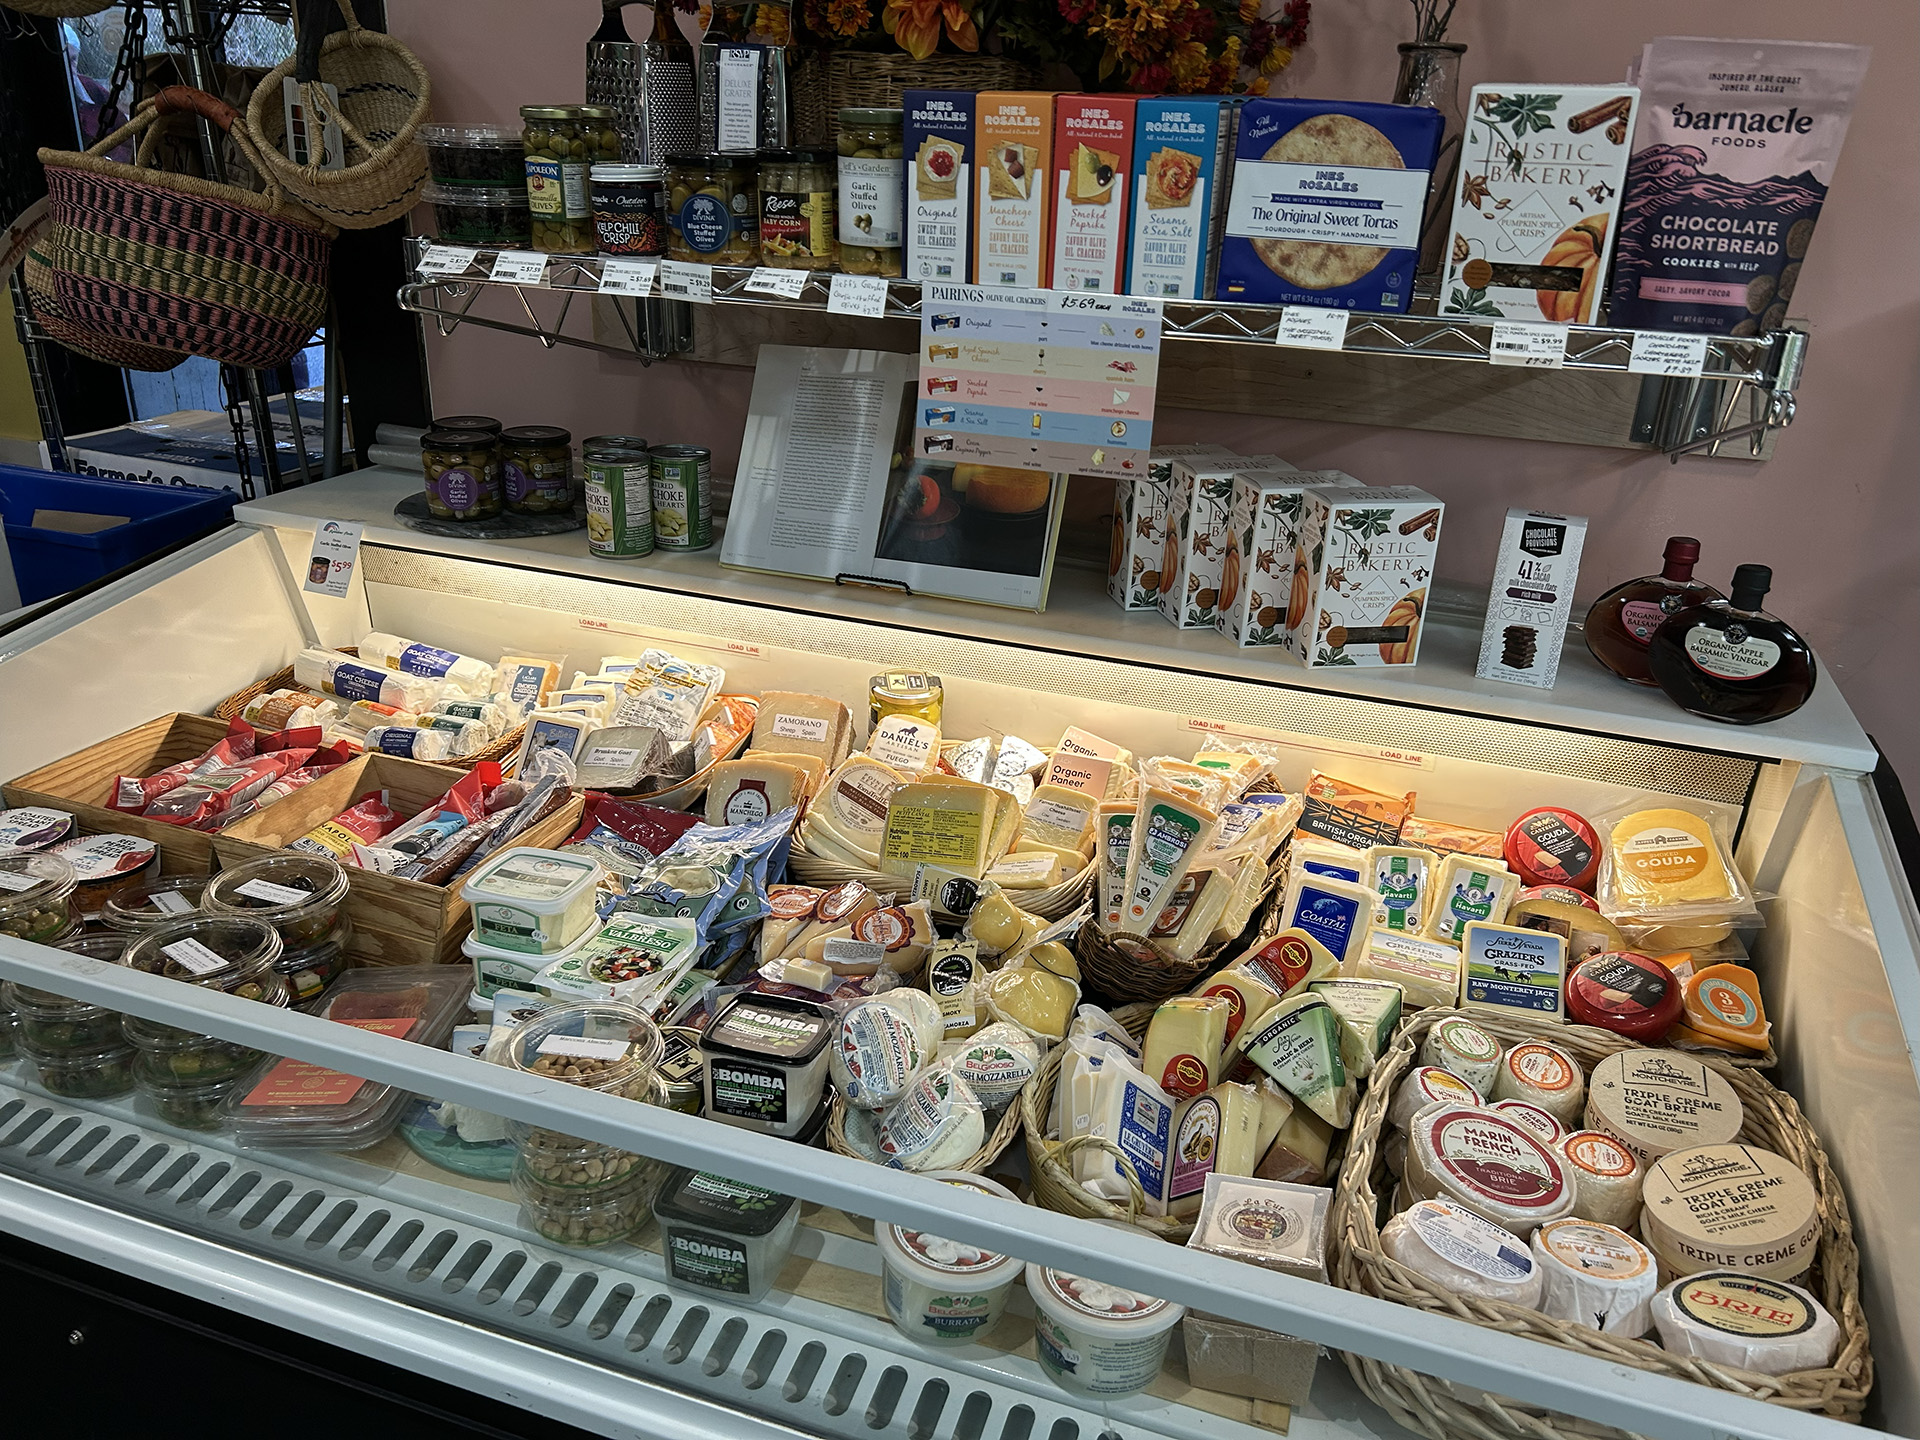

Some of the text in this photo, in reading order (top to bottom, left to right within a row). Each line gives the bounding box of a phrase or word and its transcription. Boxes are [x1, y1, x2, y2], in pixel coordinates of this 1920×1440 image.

[724, 80, 752, 88] DELUXE
[1708, 73, 1801, 84] INSPIRED BY THE COAST
[912, 110, 967, 122] ROSALES
[999, 105, 1026, 116] INES
[984, 114, 1040, 126] ROSALES
[1066, 117, 1124, 130] ROSALES
[1672, 102, 1813, 135] barnacle
[1146, 121, 1206, 134] ROSALES
[1711, 136, 1766, 149] FOODS
[1494, 140, 1594, 162] RUSTIC
[1490, 164, 1591, 186] BAKERY
[852, 182, 876, 191] Garlic
[1298, 180, 1358, 192] ROSALES
[850, 192, 878, 200] Stuffed
[852, 202, 876, 210] Olives
[764, 218, 800, 226] BABY CORN
[1252, 207, 1398, 229] The Original Sweet Tortas
[687, 222, 722, 231] Blue Cheese
[1660, 214, 1778, 236] CHOCOLATE
[603, 232, 630, 244] CRISP
[1264, 226, 1306, 234] SOURDOUGH
[1341, 232, 1379, 240] HANDMADE
[1144, 241, 1186, 254] SAVORY OLIVE
[1651, 234, 1779, 256] SHORTBREAD
[1065, 246, 1106, 260] OIL CRACKERS
[1662, 257, 1720, 270] COOKIES
[1738, 262, 1760, 272] KELP
[932, 286, 984, 302] PAIRINGS
[986, 294, 1002, 302] OLIVE
[1004, 295, 1014, 303] OIL
[1015, 296, 1046, 305] CRACKERS
[1061, 296, 1096, 309] $5.69
[1122, 306, 1156, 314] ROSALES
[589, 505, 610, 514] HEARTS
[658, 500, 684, 508] HEARTS
[1526, 528, 1557, 538] CHOCOLATE
[1526, 536, 1558, 547] PROVISIONS
[1349, 542, 1416, 555] RUSTIC
[1346, 558, 1414, 572] BAKERY
[1533, 571, 1550, 582] CACAO
[1378, 596, 1395, 604] SPICE
[1626, 610, 1662, 622] ORGANIC
[746, 646, 760, 654] LINE
[1698, 638, 1764, 658] ORGANIC APPLE
[407, 648, 452, 666] GOAT CHEESE
[1690, 644, 1769, 668] BALSAMIC VINEGAR
[336, 671, 379, 688] GOAT CHEESE
[454, 706, 475, 714] GARLIC
[778, 716, 822, 728] ZAMORANO
[1188, 720, 1208, 729] LOAD
[550, 728, 574, 739] Billie's
[880, 730, 928, 750] DANIEL'S
[886, 754, 909, 764] FUEGO
[1380, 750, 1402, 760] LOAD
[1054, 765, 1092, 780] Organic
[1051, 774, 1084, 788] Paneer
[19, 812, 56, 821] ROASTED
[730, 808, 764, 818] MANCHEGO
[7, 820, 40, 828] SPREAD
[9, 815, 51, 826] EGGPLANT
[338, 814, 370, 832] OLLI
[1332, 834, 1350, 844] DAIRY
[1536, 828, 1570, 842] GOUDA
[86, 848, 120, 858] SPREAD
[1636, 855, 1696, 868] GOUDA
[516, 873, 550, 884] FETA
[1455, 901, 1486, 916] Havarti
[1300, 910, 1346, 930] COASTAL
[494, 924, 518, 934] FETA
[607, 929, 671, 949] VALBRESO
[1484, 948, 1545, 966] GRAZIERS
[1494, 959, 1534, 970] GRASS-FED
[1600, 963, 1634, 982] GOUDA
[496, 978, 518, 988] FETA
[1472, 980, 1488, 988] RAW
[1490, 983, 1534, 995] MONTEREY
[1535, 990, 1555, 998] JACK
[1719, 991, 1734, 1006] 3
[740, 1009, 820, 1033] BOMBA
[1262, 1017, 1296, 1042] ORGANIC
[882, 1008, 894, 1026] FRESH
[888, 1026, 905, 1088] MOZZARELLA
[1272, 1052, 1294, 1068] GARLIC
[1299, 1037, 1314, 1050] HERB
[966, 1061, 1014, 1072] BELGIOIOSO
[718, 1069, 785, 1090] BOMBA
[976, 1068, 1032, 1082] MOZZARELLA
[716, 1080, 740, 1088] BASIL
[742, 1082, 782, 1096] BURRATA
[1624, 1096, 1698, 1115] GOAT BRIE
[1464, 1126, 1514, 1144] MARIN
[1464, 1136, 1521, 1156] FRENCH
[1490, 1174, 1518, 1186] BRIE
[1682, 1188, 1734, 1205] TRIPLE
[1690, 1190, 1766, 1212] GOAT BRIE
[1243, 1198, 1285, 1211] La Tur
[1700, 1204, 1776, 1224] GOAT'S MILK CHEESE
[674, 1238, 746, 1264] BOMBA
[1678, 1241, 1736, 1266] TRIPLE
[1689, 1289, 1794, 1326] BRIE
[934, 1317, 980, 1326] BURRATA
